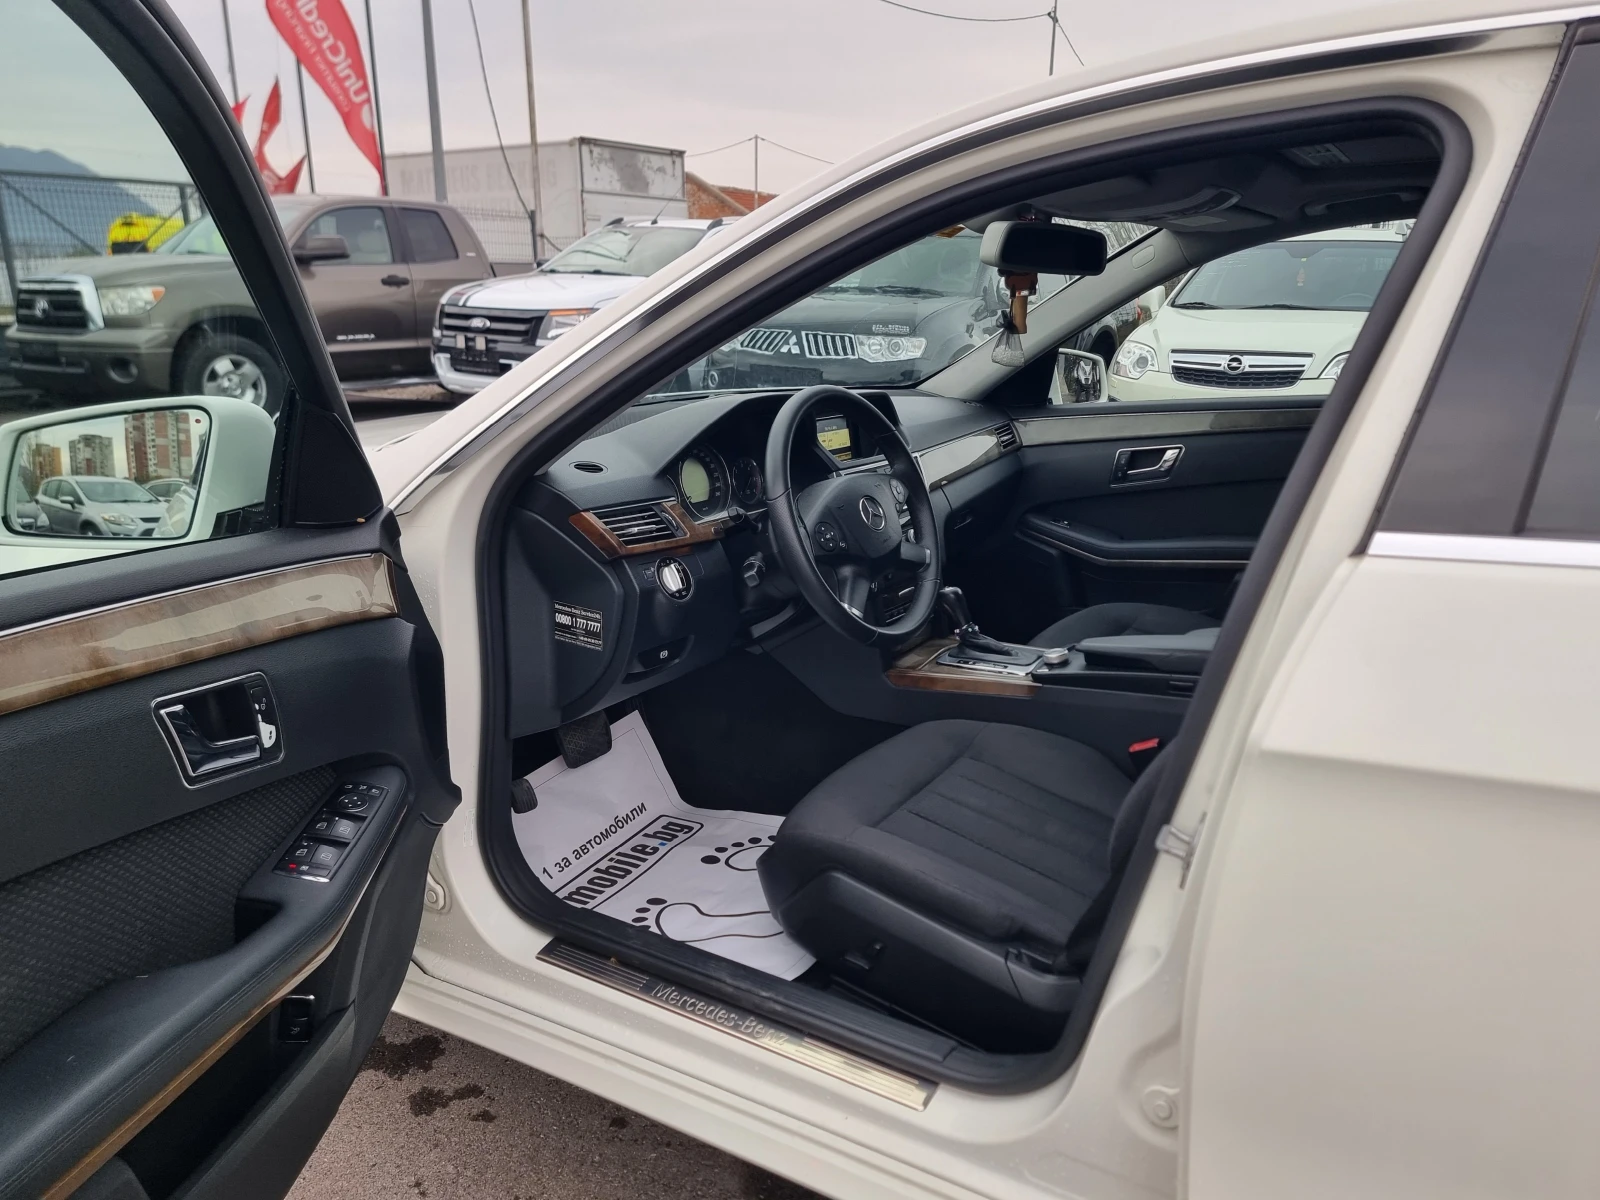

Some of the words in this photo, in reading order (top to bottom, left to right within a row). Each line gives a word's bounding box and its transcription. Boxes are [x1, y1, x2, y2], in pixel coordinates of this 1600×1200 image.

[556, 612, 571, 625] 00800
[577, 618, 586, 629] 777
[587, 621, 600, 632] 7777
[542, 867, 553, 879] 1
[554, 856, 572, 873] за
[572, 802, 647, 861] автомобили
[562, 821, 694, 905] mobile.bg
[651, 983, 789, 1046] Mercedes-Benz
